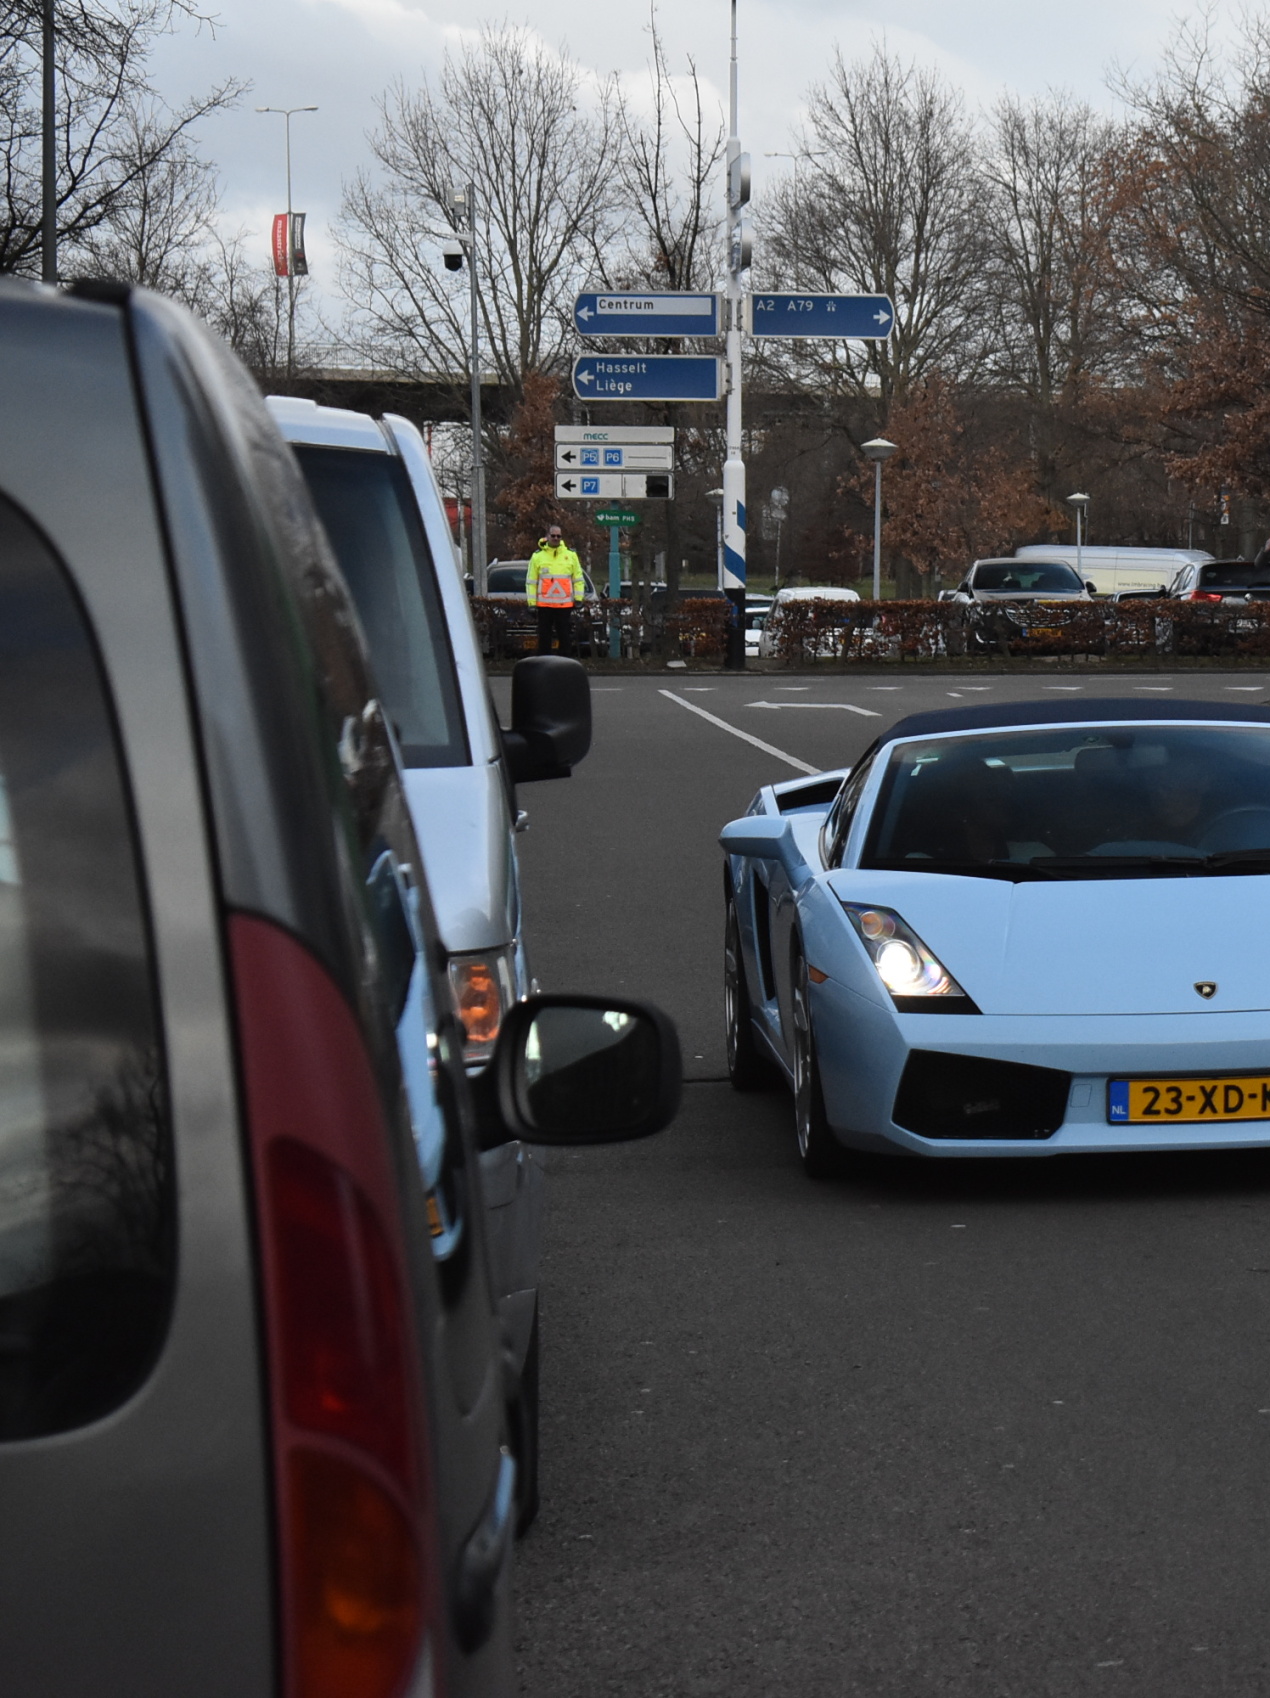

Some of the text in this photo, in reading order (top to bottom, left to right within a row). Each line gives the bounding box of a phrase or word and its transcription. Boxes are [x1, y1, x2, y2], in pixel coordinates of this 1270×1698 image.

[598, 298, 655, 311] Centrum
[756, 300, 814, 312] A2 A79
[596, 362, 647, 374] Hasselt
[596, 379, 633, 392] Liège
[583, 452, 620, 462] P5 P6
[583, 480, 596, 490] P7
[1111, 1105, 1127, 1114] NL
